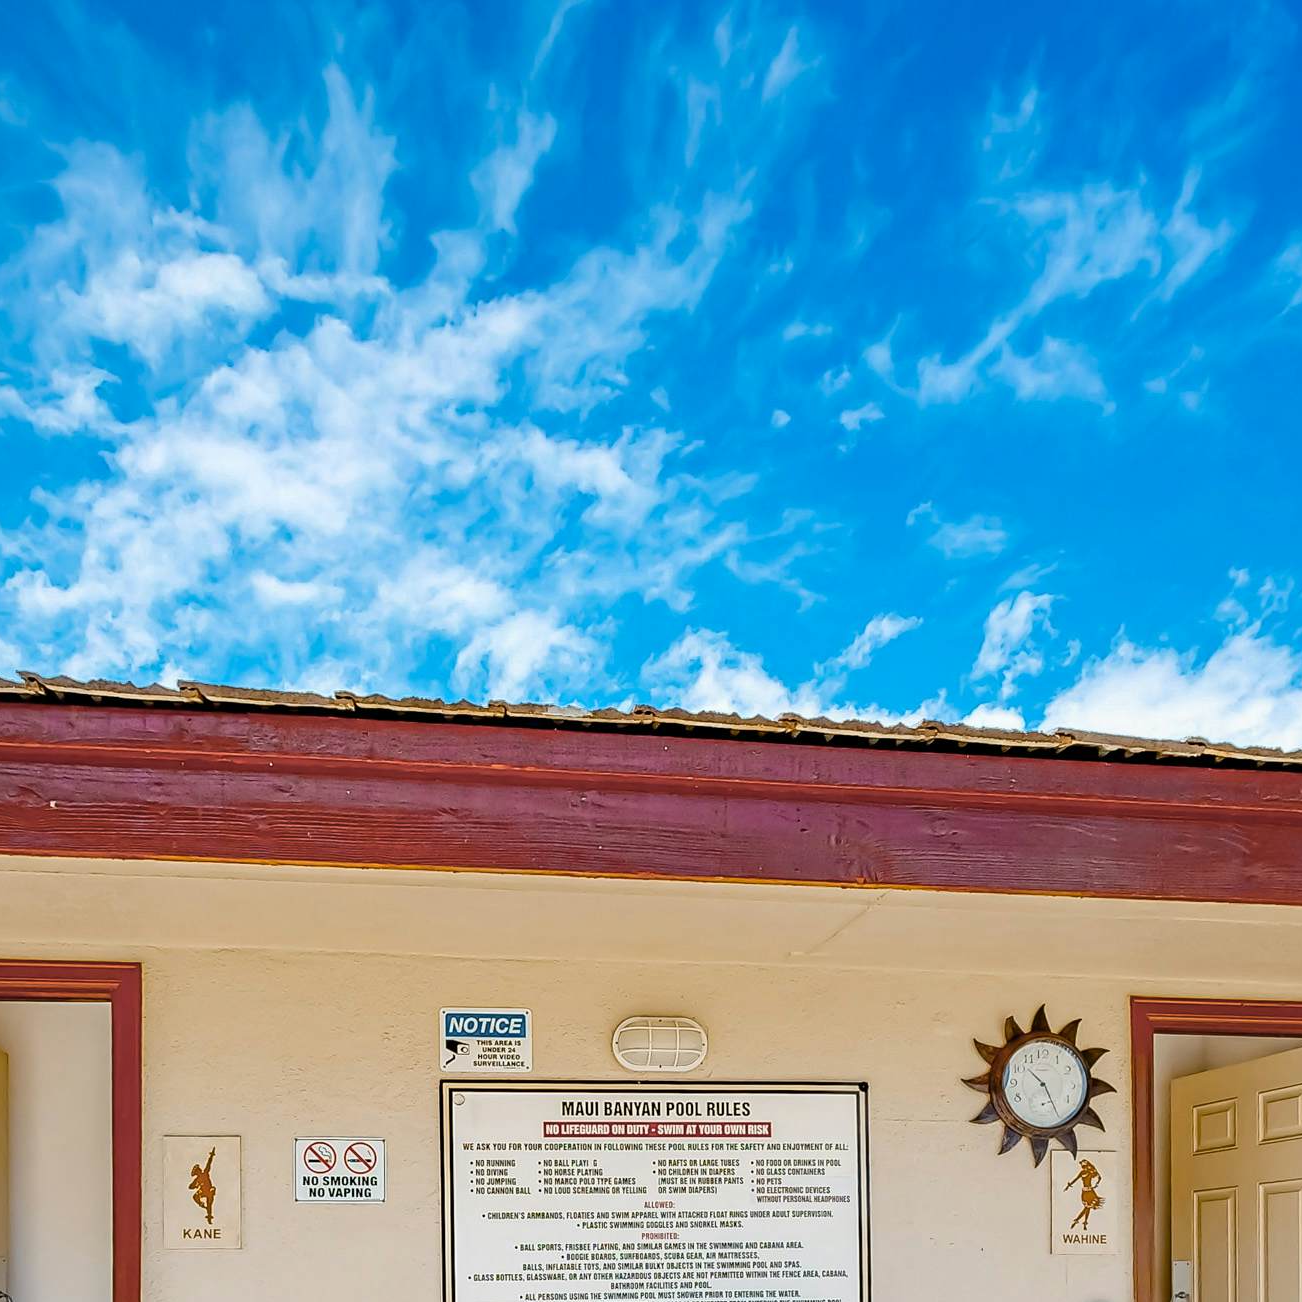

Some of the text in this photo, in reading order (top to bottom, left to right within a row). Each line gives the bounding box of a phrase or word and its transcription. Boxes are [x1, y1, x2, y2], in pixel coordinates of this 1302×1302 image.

[448, 1017, 522, 1034] NOTICE
[1024, 1054, 1034, 1063] 11
[1037, 1049, 1049, 1059] 12
[1055, 1055, 1059, 1064] 1
[1014, 1064, 1025, 1073] 10
[1010, 1079, 1018, 1088] 9
[1014, 1093, 1022, 1102] 8
[562, 1101, 750, 1116] MAUI BANYAN POOL RULES
[546, 1124, 560, 1134] NO
[561, 1124, 610, 1134] LIFEGUARD
[612, 1124, 625, 1134] ON
[627, 1124, 649, 1134] DUTY
[658, 1124, 684, 1134] SWIM
[686, 1124, 697, 1134] AT
[699, 1124, 722, 1134] YOUR
[724, 1124, 746, 1134] OWN
[748, 1124, 769, 1134] RISK
[303, 1176, 378, 1186] NO SMOKING
[309, 1188, 372, 1198] NO VAPING
[183, 1229, 221, 1239] KANE
[1063, 1234, 1106, 1244] WAHINE
